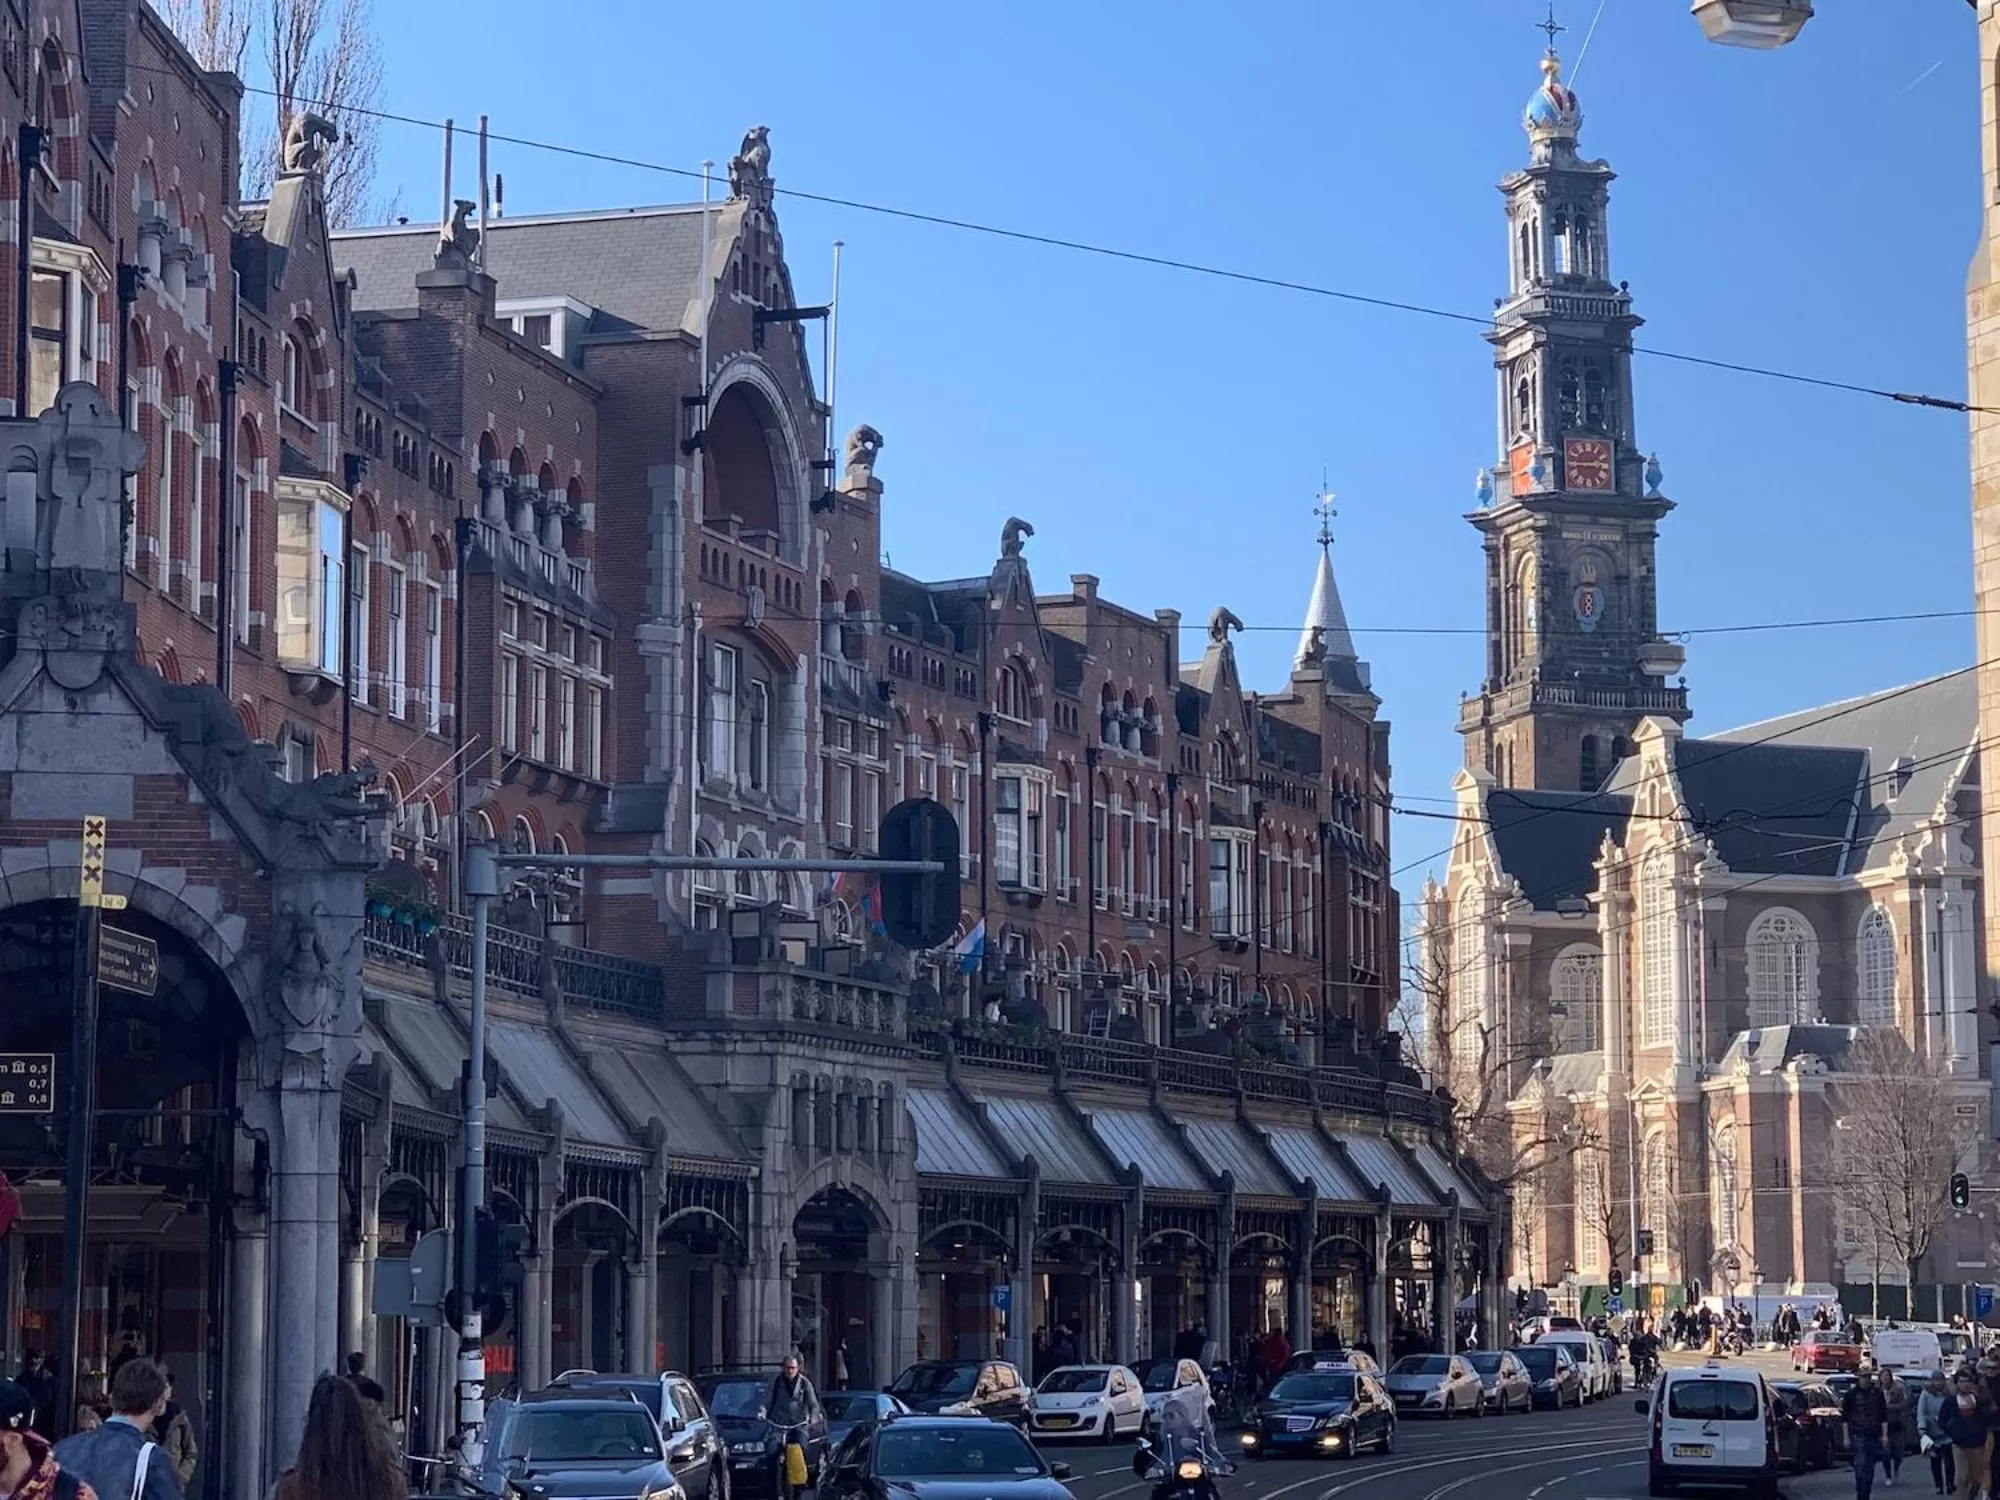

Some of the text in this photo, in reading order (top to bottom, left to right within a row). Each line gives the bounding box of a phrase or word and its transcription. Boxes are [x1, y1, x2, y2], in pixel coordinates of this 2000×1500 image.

[30, 1064, 48, 1074] 0,5
[29, 1079, 47, 1089] 0,7
[998, 1292, 1006, 1304] P
